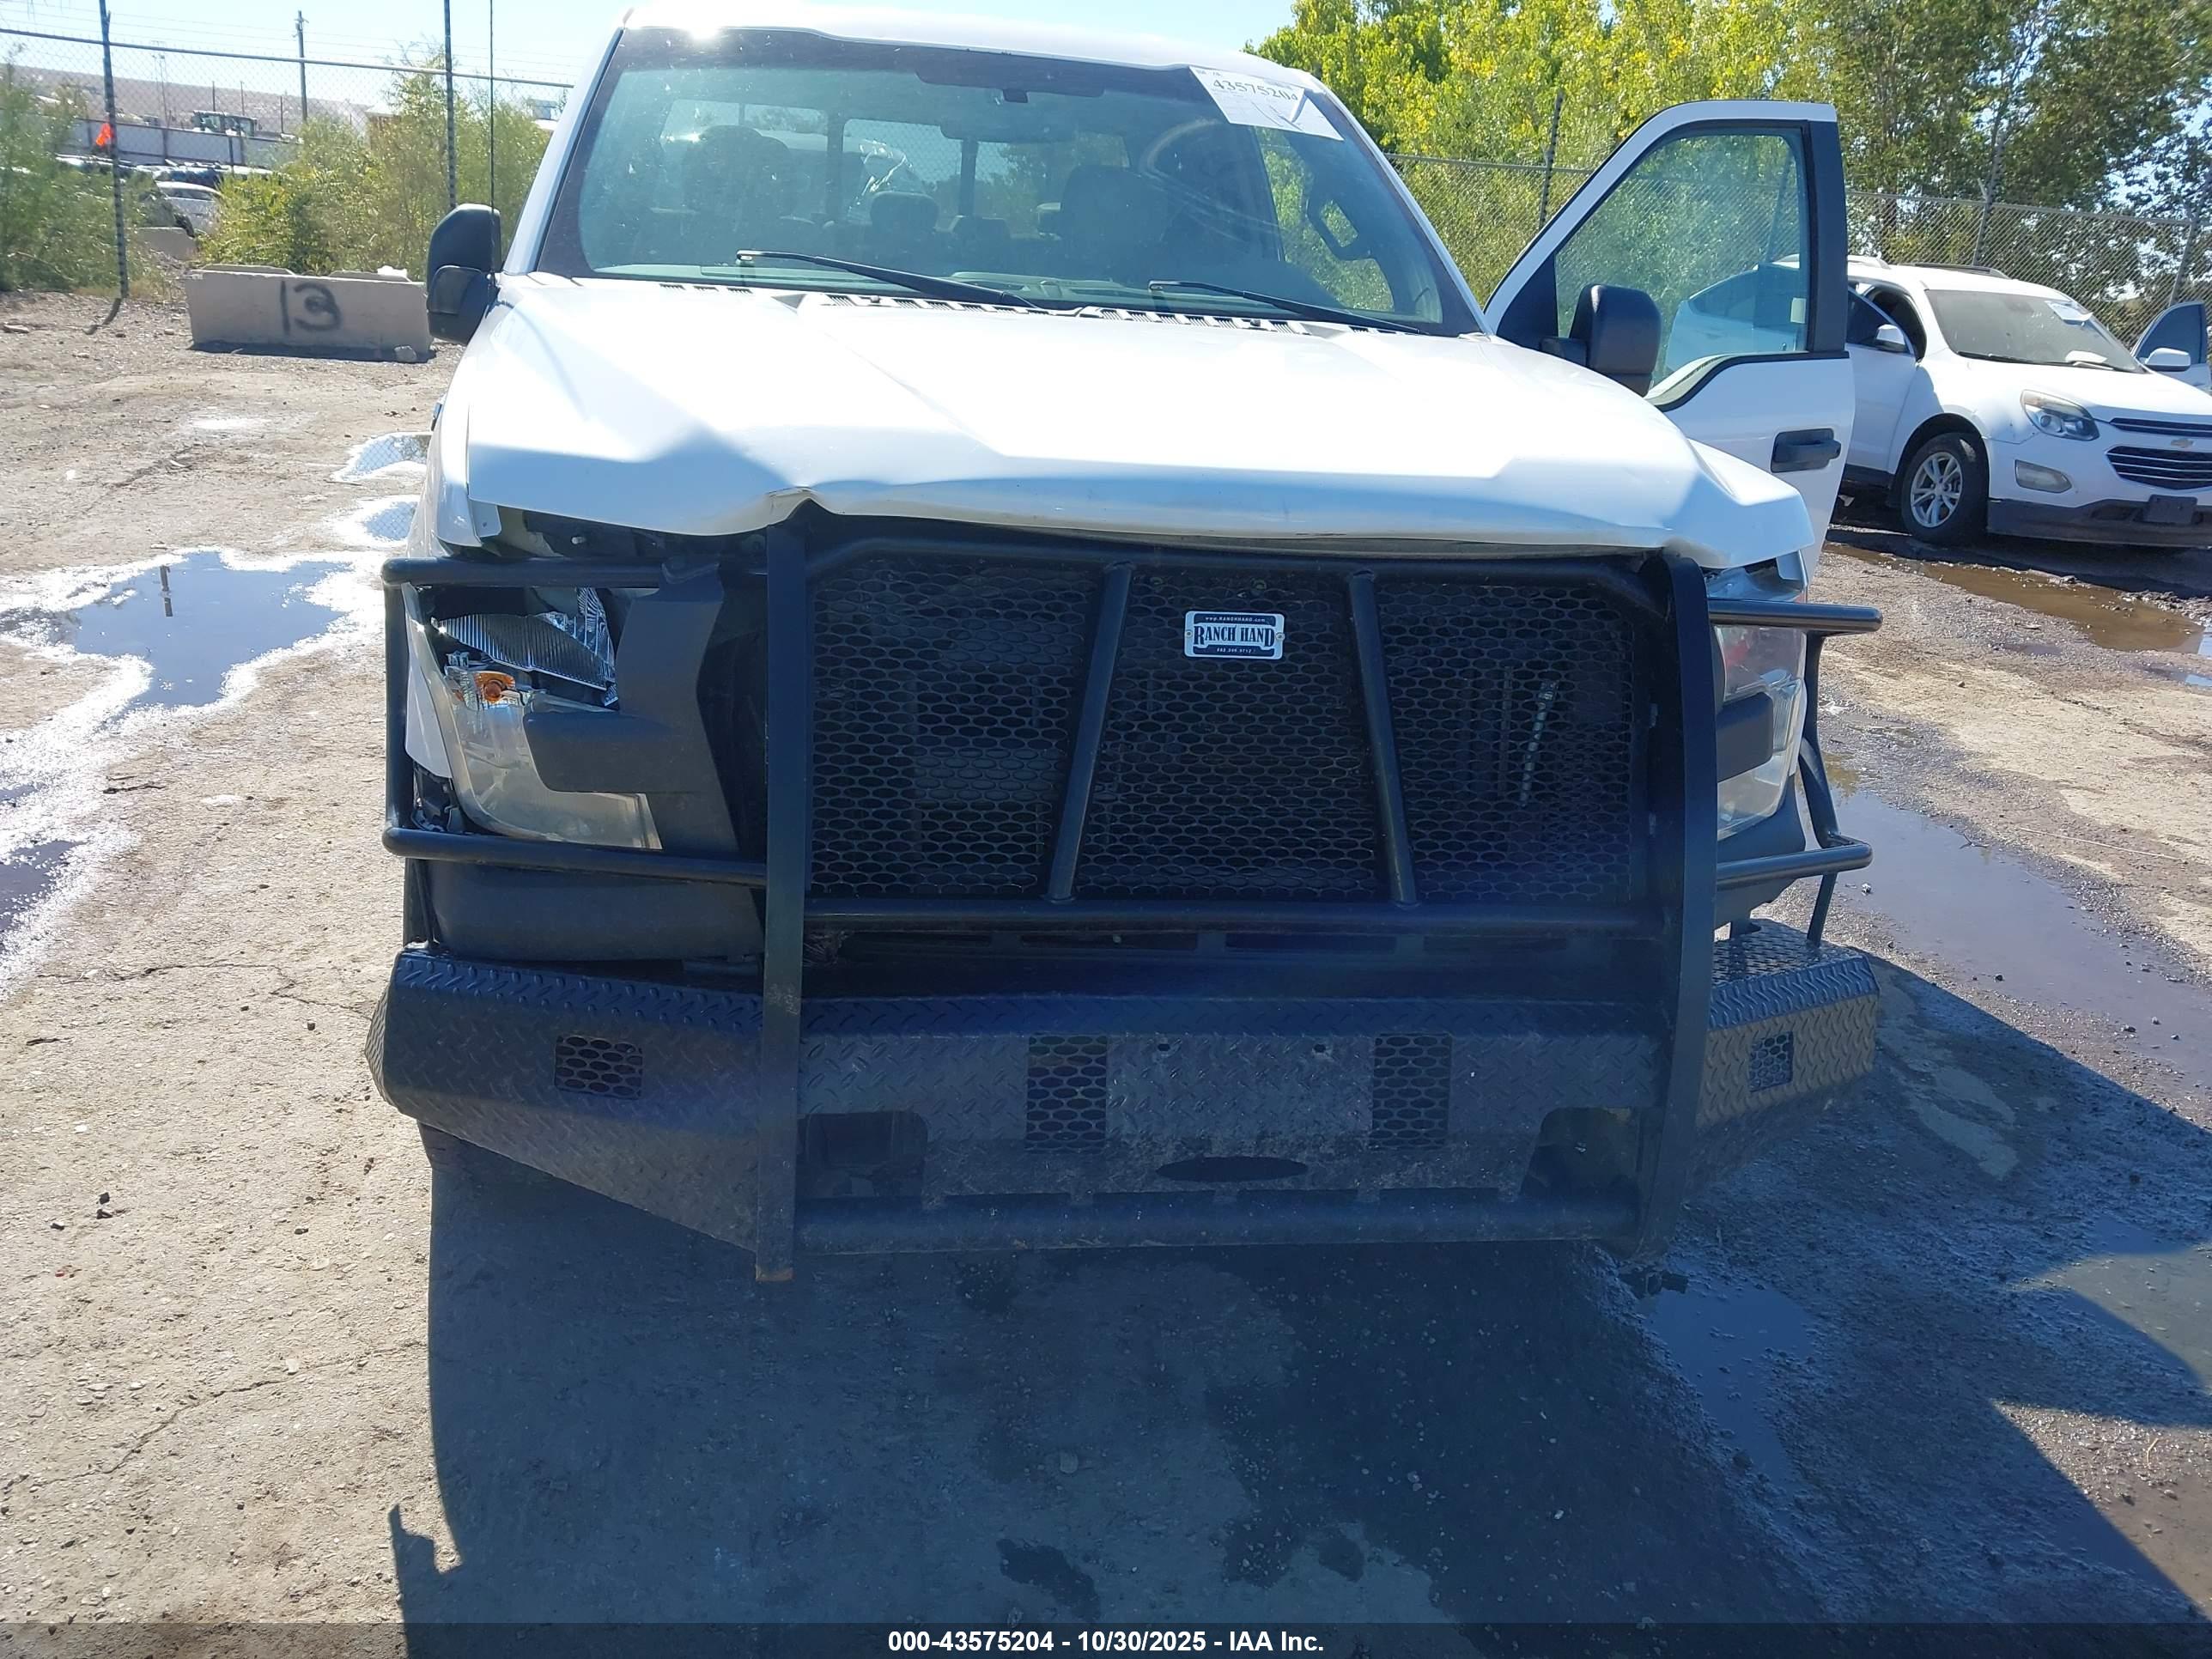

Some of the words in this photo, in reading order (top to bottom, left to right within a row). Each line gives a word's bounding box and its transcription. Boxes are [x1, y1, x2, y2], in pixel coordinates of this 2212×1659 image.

[279, 280, 343, 336] 13
[1194, 625, 1237, 645] RANCH
[1240, 628, 1275, 647] HAND
